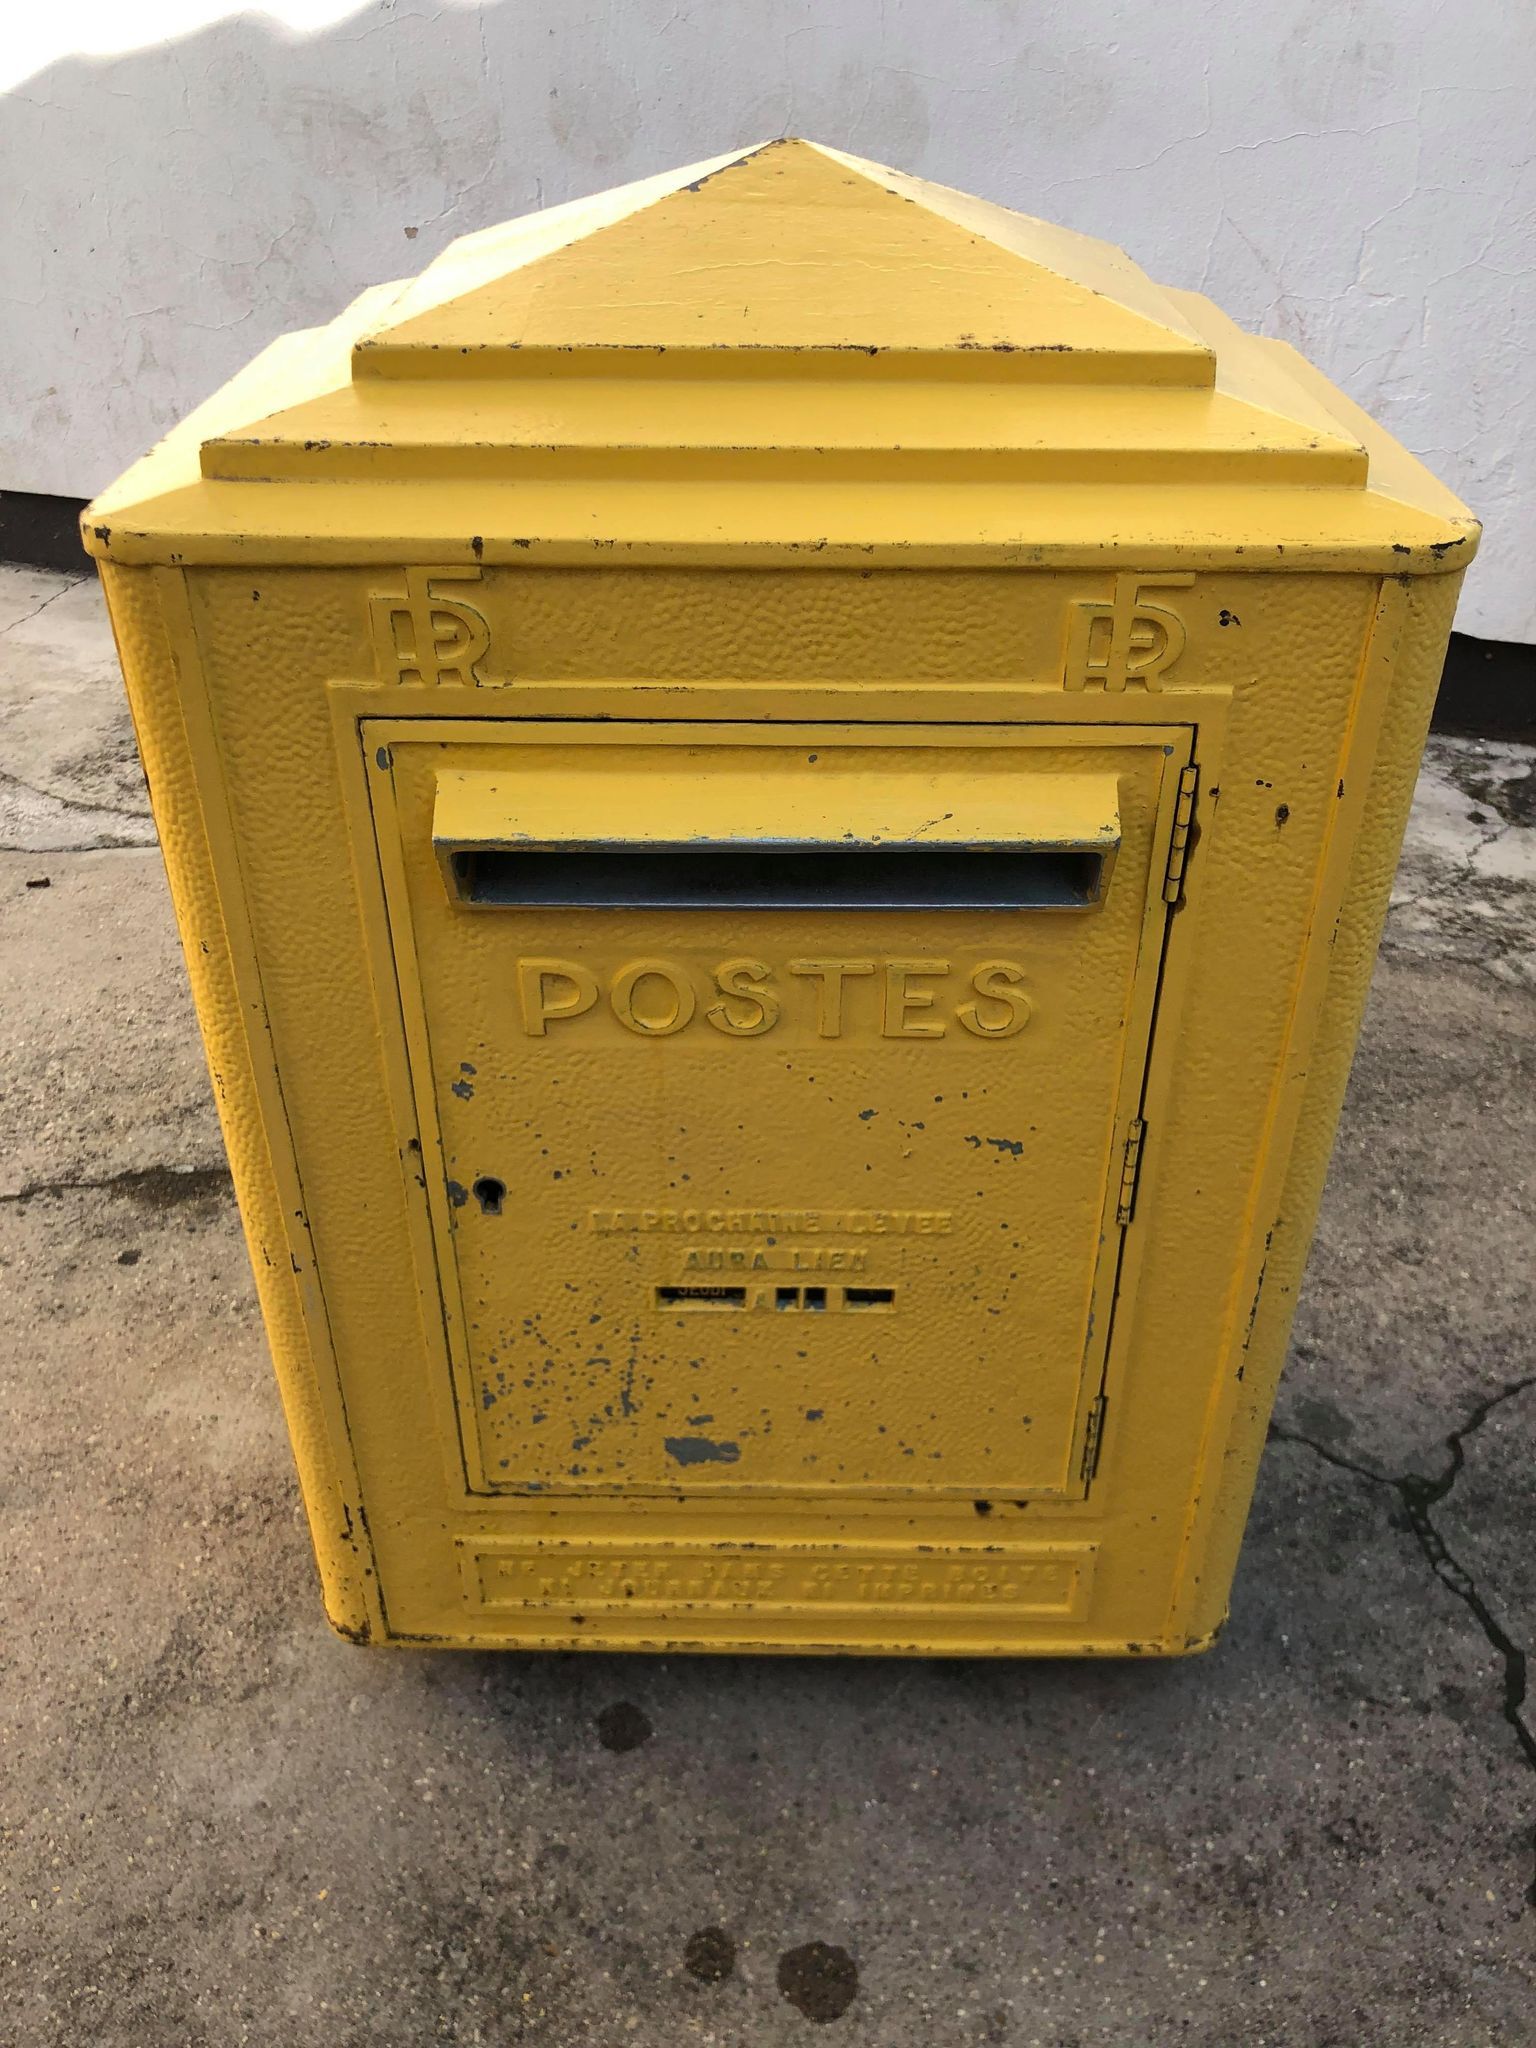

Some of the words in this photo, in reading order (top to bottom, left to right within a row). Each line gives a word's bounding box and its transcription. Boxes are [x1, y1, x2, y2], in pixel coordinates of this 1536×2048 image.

[517, 957, 1035, 1038] POSTES
[590, 1209, 638, 1234] LA
[684, 1249, 771, 1272] AURA
